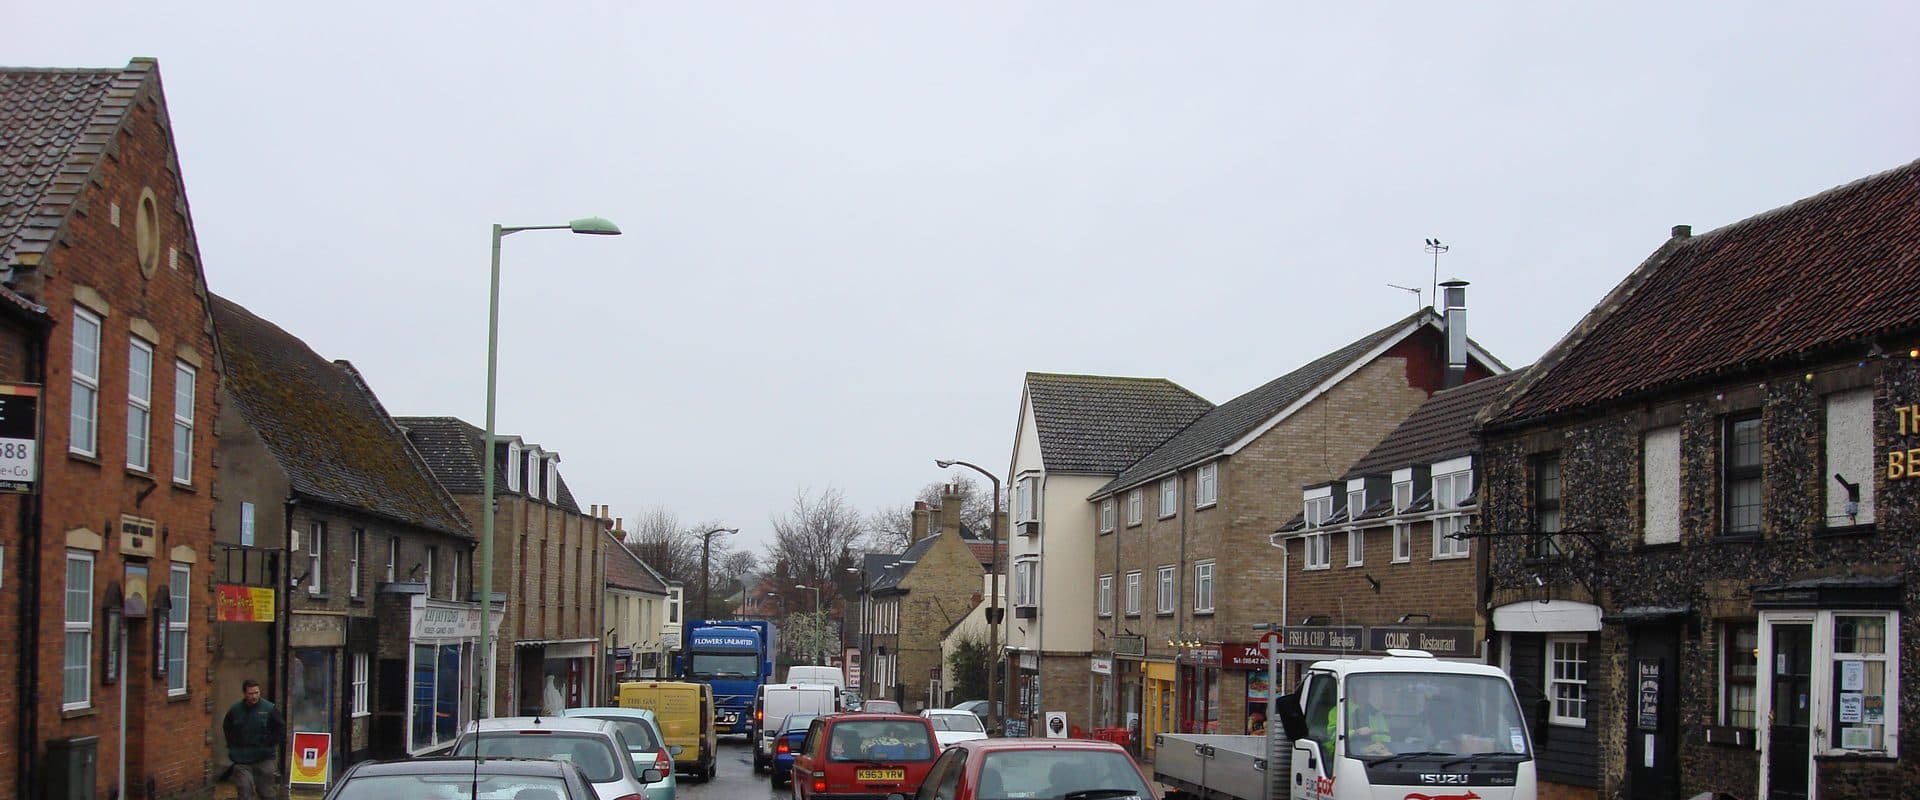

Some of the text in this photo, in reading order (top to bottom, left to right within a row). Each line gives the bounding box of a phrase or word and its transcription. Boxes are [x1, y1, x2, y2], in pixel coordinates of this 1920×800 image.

[0, 443, 27, 459] 88
[1289, 631, 1302, 646] FISH
[1303, 632, 1309, 646] &
[1310, 631, 1326, 646] CHIP
[1384, 632, 1456, 651] COLLINS Restaurant
[859, 770, 883, 779] K963
[1420, 773, 1469, 784] ISUZU
